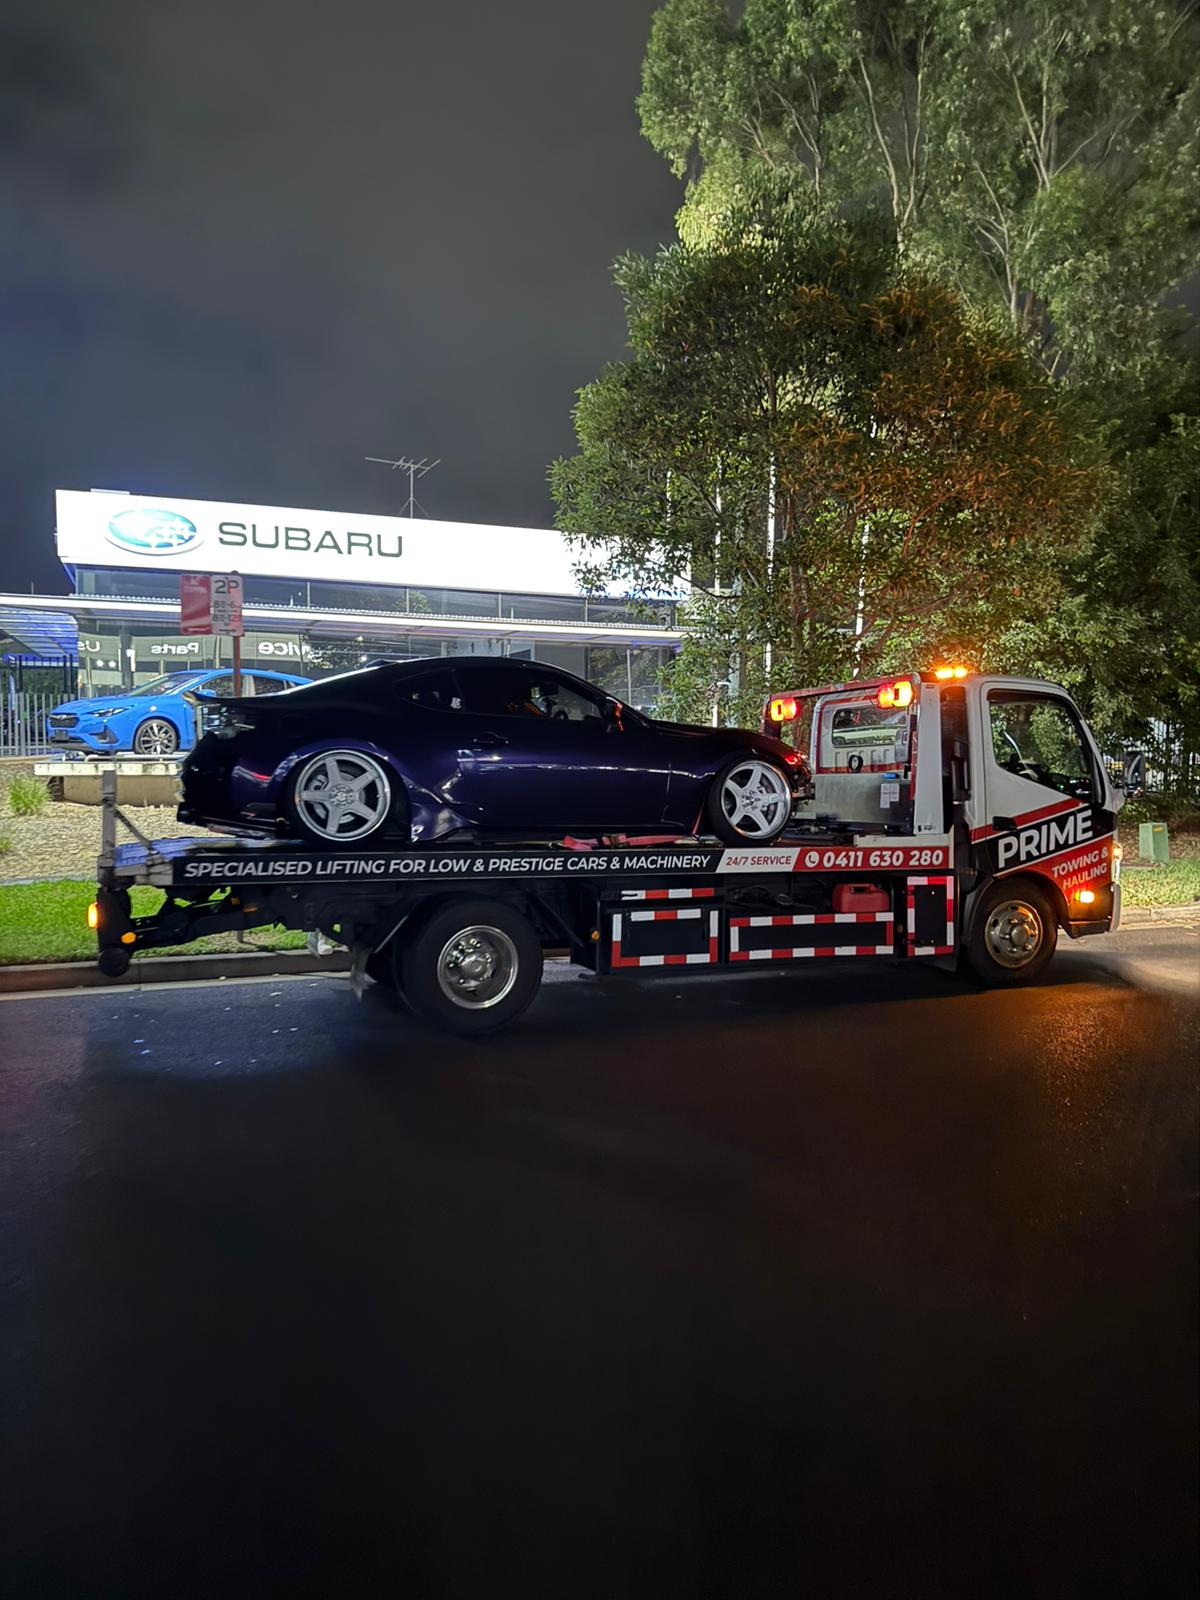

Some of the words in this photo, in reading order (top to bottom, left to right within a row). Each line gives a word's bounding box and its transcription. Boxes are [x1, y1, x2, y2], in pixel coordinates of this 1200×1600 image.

[218, 522, 403, 558] SUBARU
[214, 579, 239, 594] 2P
[998, 809, 1093, 869] PRIME
[185, 861, 312, 877] SPECIALISED
[315, 859, 385, 875] LIFTING
[388, 859, 425, 873] FOR
[428, 858, 471, 872] LOW
[473, 857, 485, 872] &
[488, 857, 563, 871] PRESTIGE
[566, 856, 607, 870] CARS
[610, 856, 621, 869] &
[623, 855, 711, 869] MACHINERY
[726, 856, 749, 867] 24/7
[750, 855, 792, 866] SERVICE
[823, 851, 862, 867] 0411
[869, 850, 903, 866] 630
[909, 849, 943, 866] 280
[1052, 852, 1099, 878] TOWING
[1100, 847, 1108, 860] &
[1062, 863, 1108, 890] HAULING
